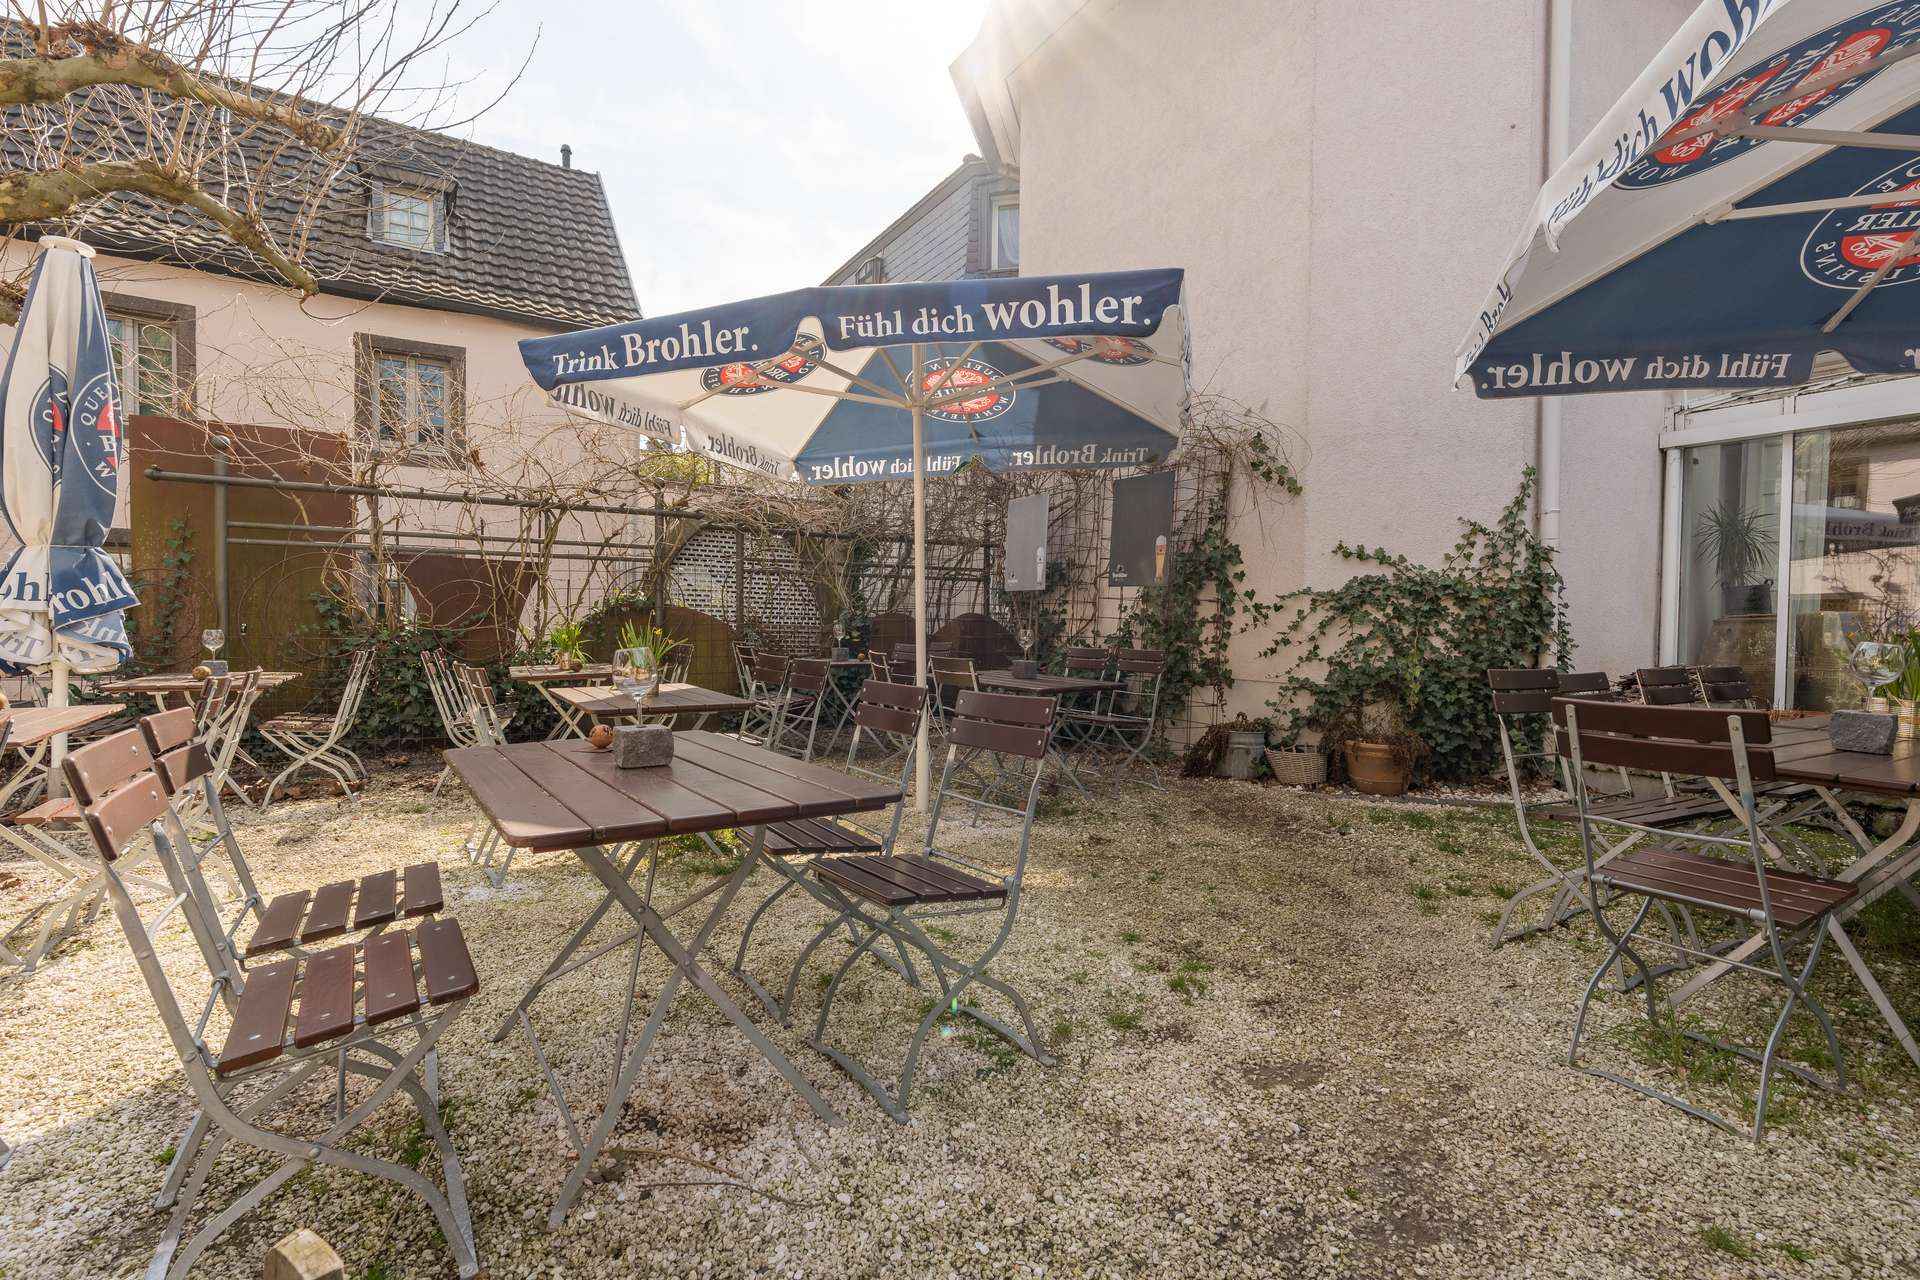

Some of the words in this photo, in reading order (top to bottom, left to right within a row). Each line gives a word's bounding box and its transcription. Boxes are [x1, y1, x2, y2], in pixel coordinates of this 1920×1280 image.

[837, 310, 904, 340] Fühl
[911, 304, 976, 336] dich
[981, 283, 1152, 330] wohler.
[553, 344, 620, 376] Trink
[620, 319, 758, 368] Brohler.
